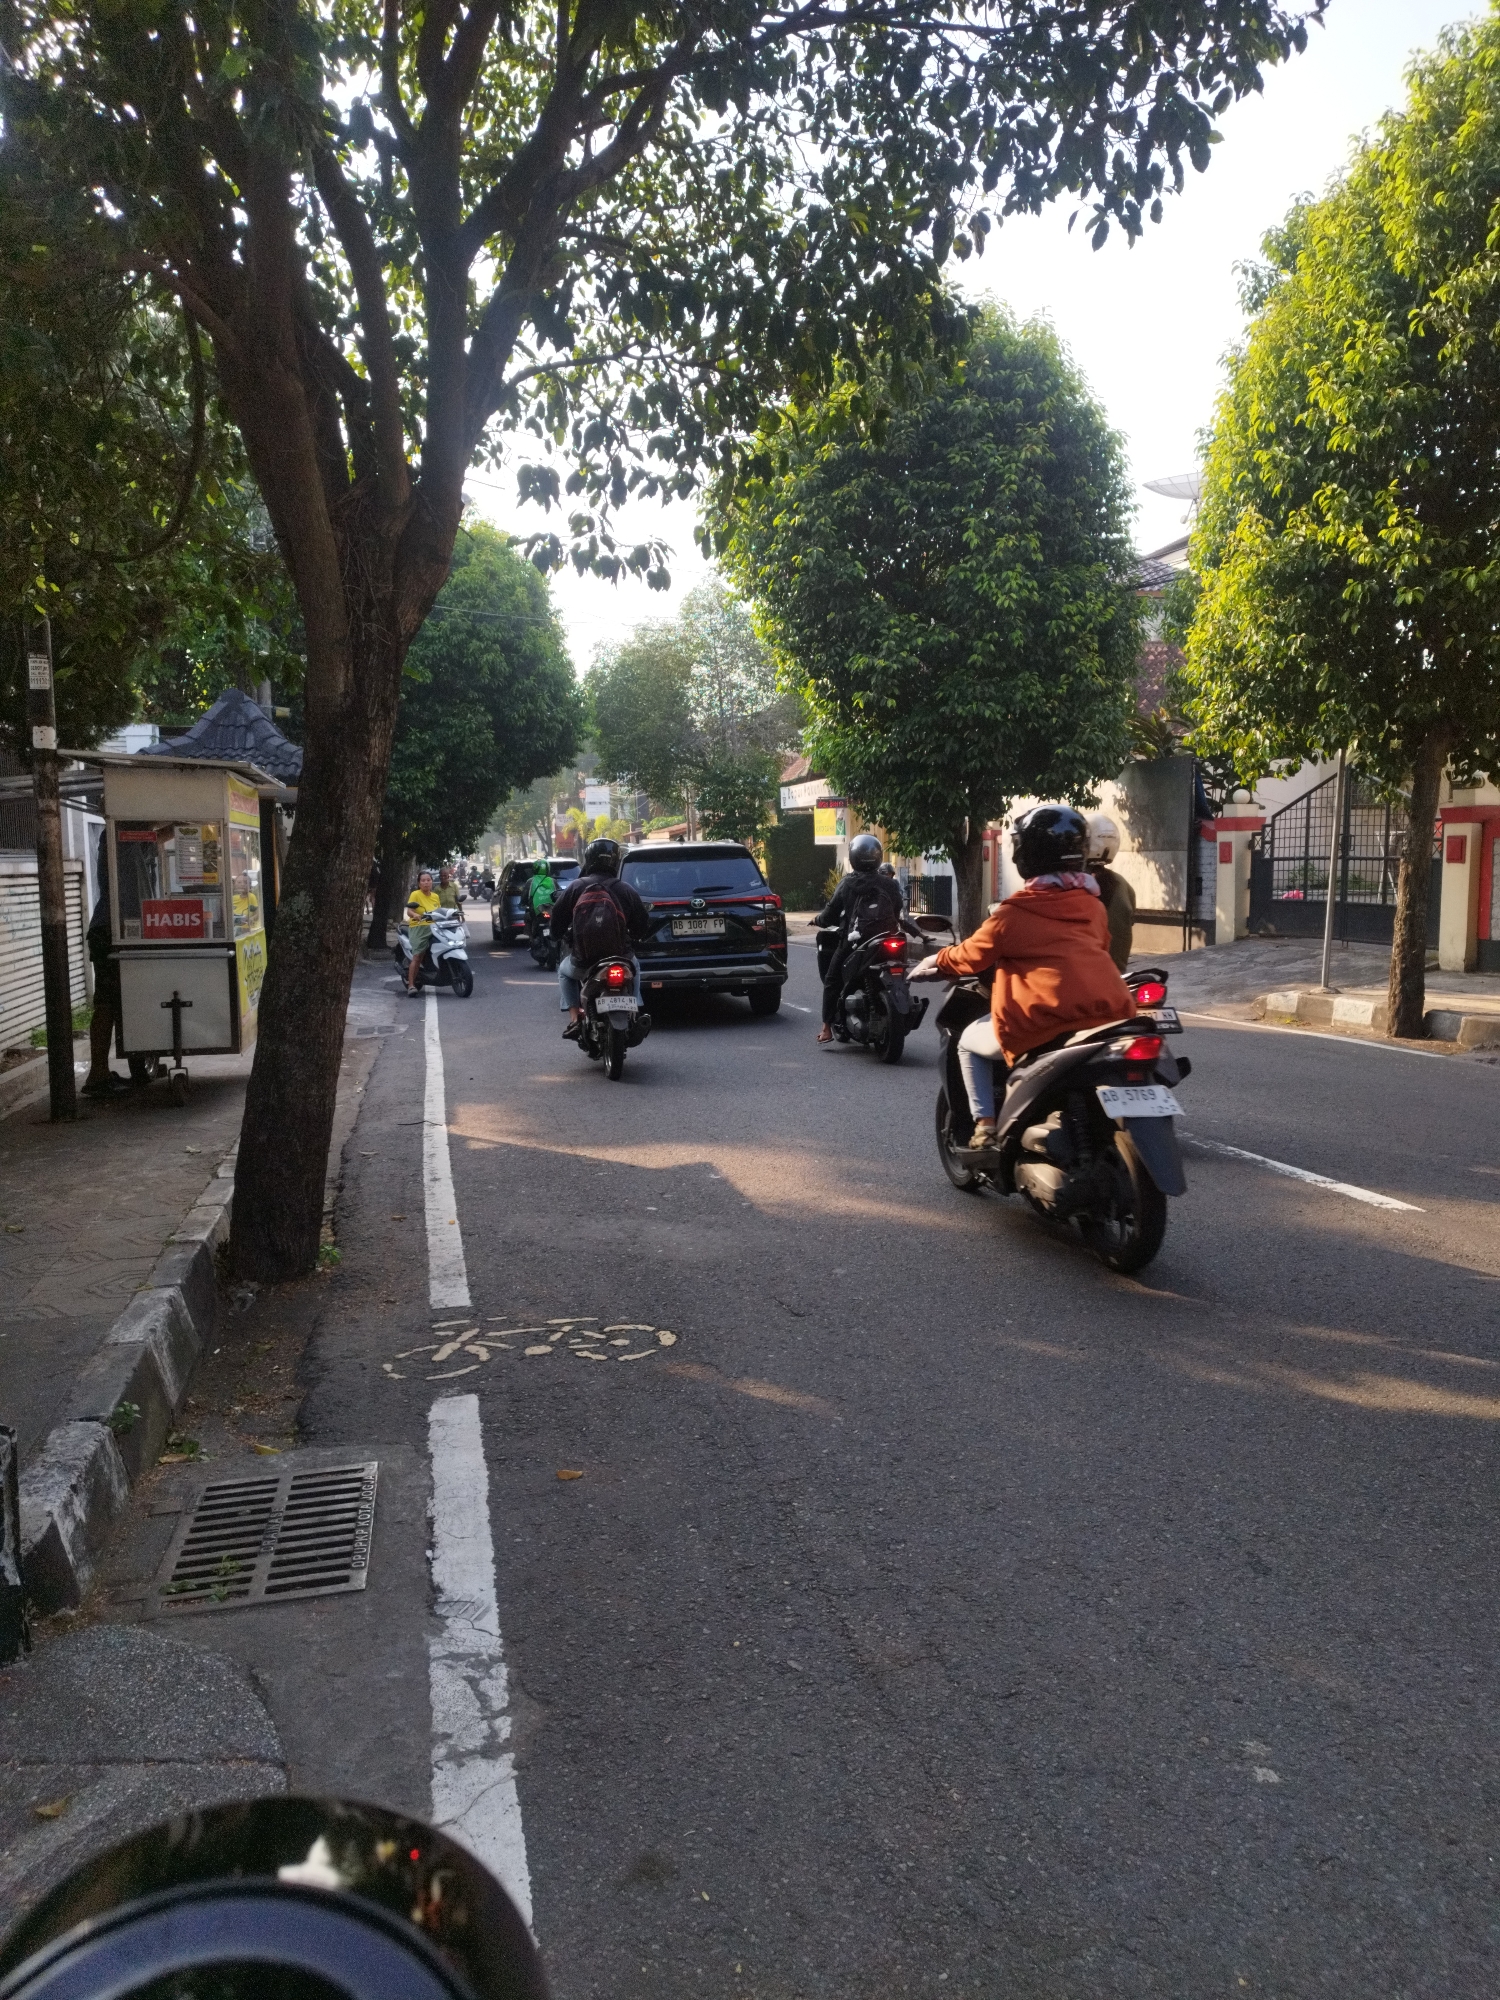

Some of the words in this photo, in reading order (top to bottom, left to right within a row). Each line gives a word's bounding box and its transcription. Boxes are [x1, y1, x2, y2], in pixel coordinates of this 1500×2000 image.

[146, 913, 201, 927] HABIS
[674, 921, 683, 930] AB
[688, 920, 708, 929] 1087
[713, 918, 724, 928] FP
[1101, 1089, 1119, 1103] AB
[1124, 1088, 1157, 1101] 5769
[362, 1475, 375, 1500] JOGJA
[357, 1503, 372, 1526] KOTA
[260, 1506, 285, 1552] DRAINASE
